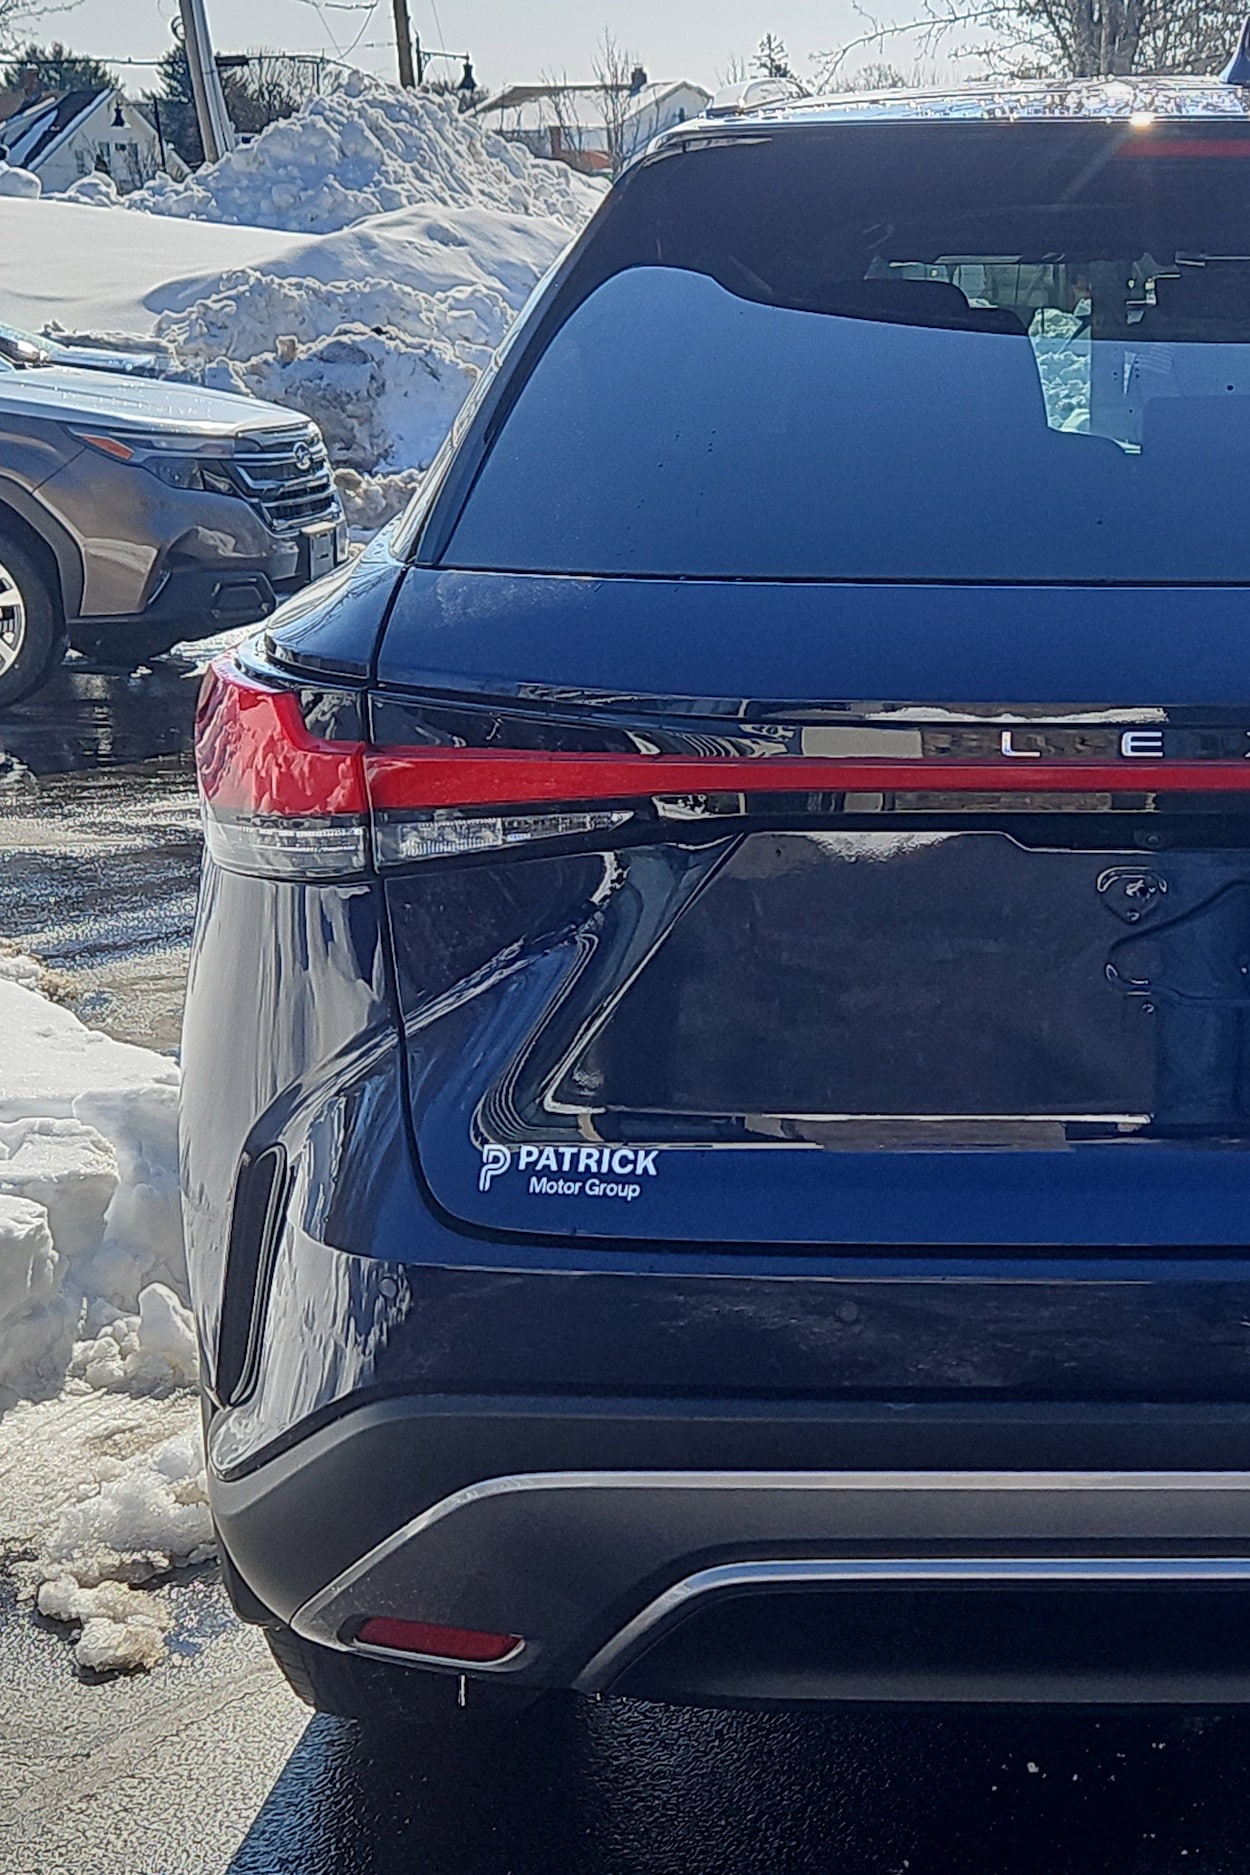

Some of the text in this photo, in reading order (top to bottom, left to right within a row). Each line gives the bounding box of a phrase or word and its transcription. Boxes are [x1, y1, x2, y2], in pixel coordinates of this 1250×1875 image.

[518, 1145, 659, 1176] PATRICK
[528, 1176, 641, 1201] Motor Group
